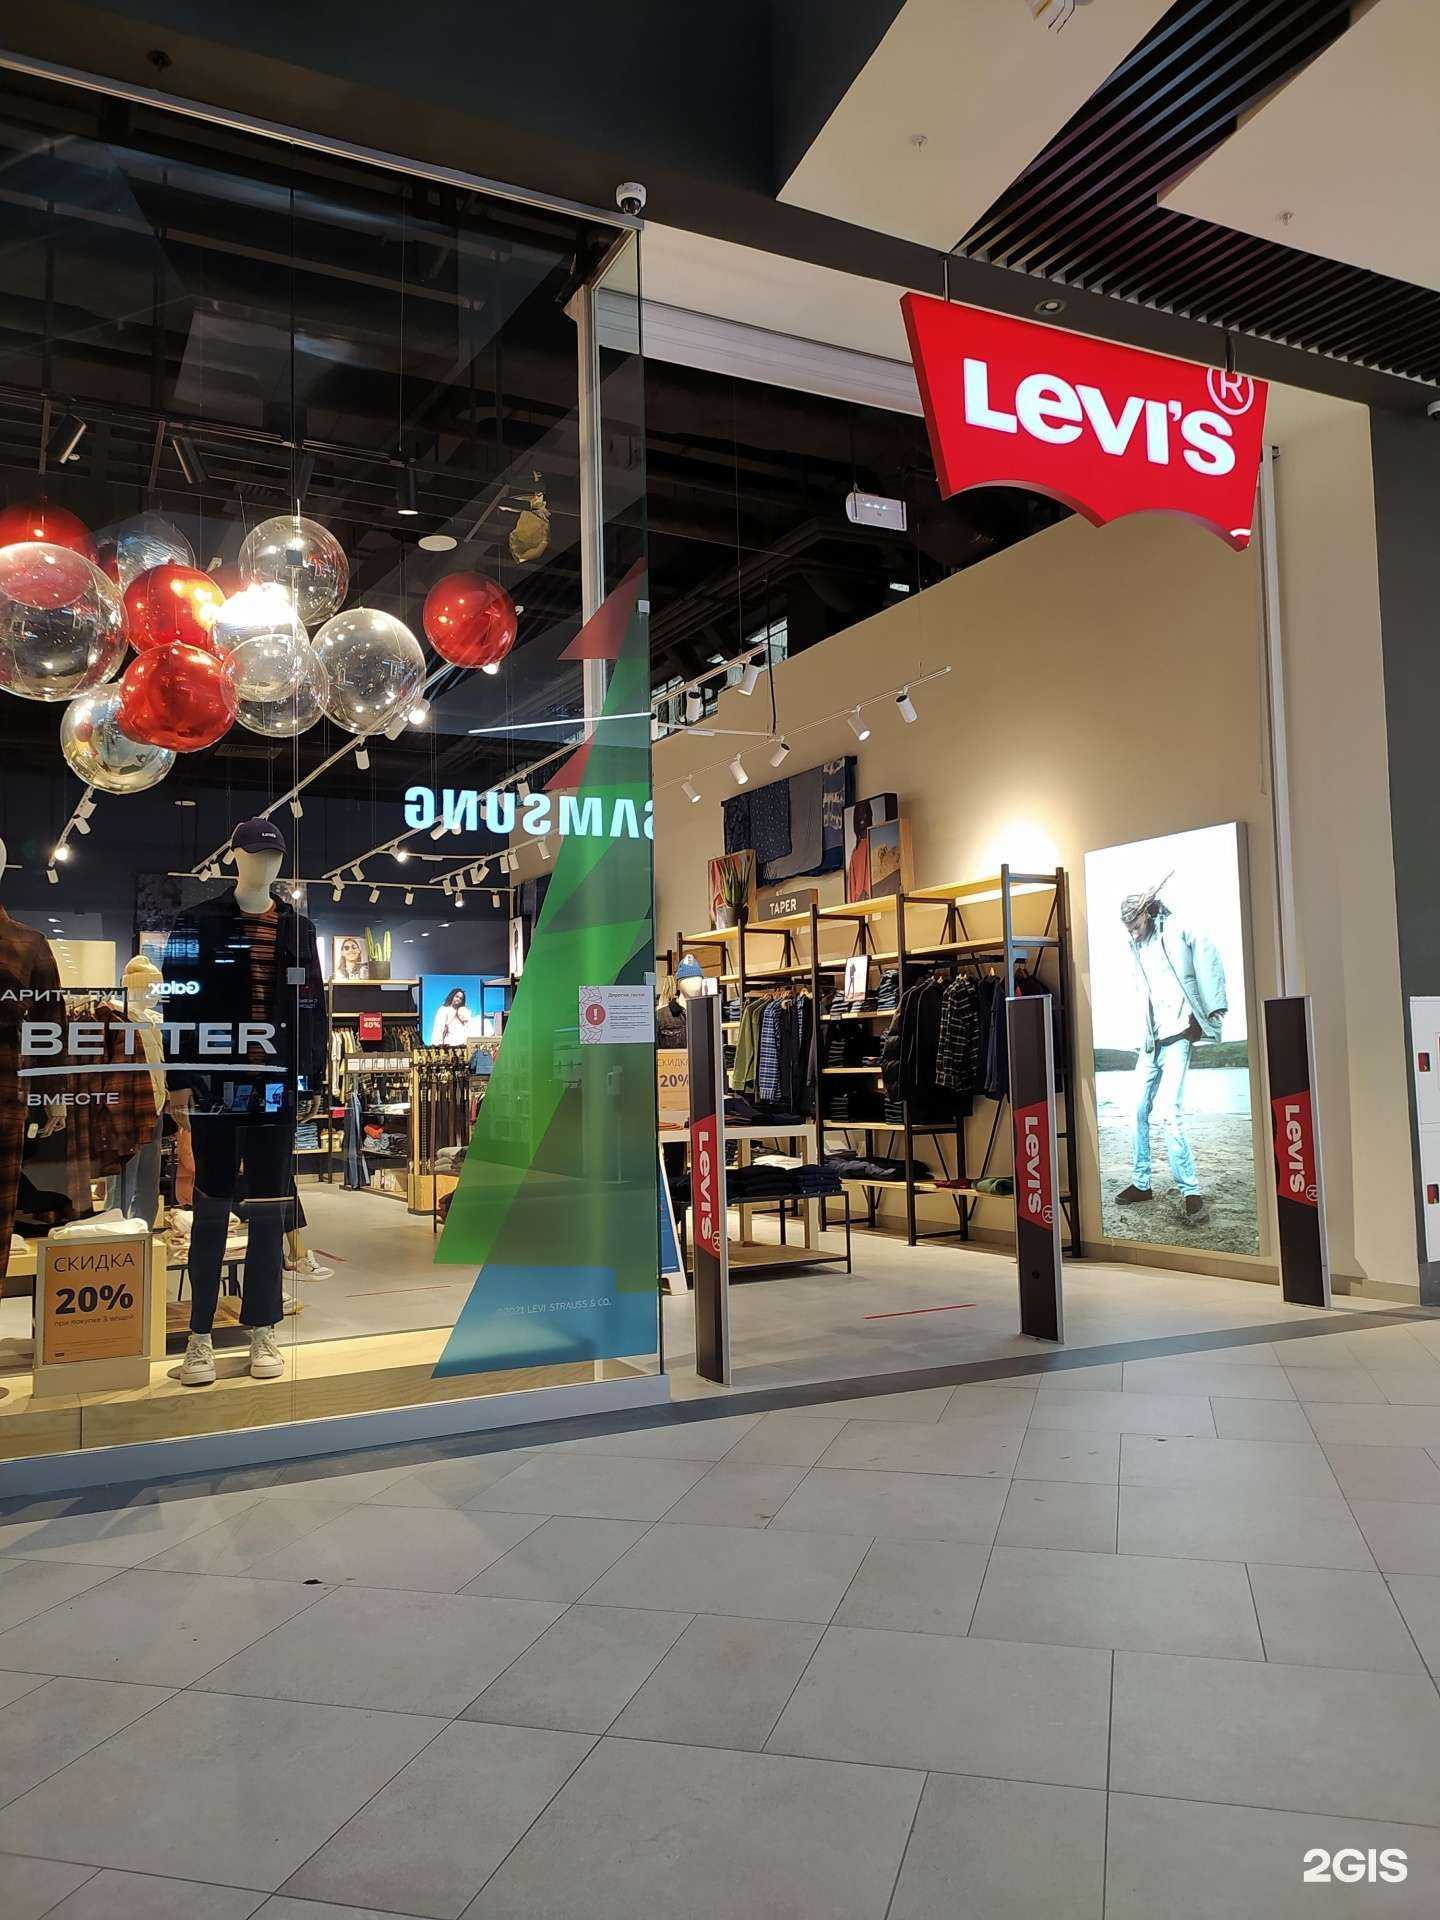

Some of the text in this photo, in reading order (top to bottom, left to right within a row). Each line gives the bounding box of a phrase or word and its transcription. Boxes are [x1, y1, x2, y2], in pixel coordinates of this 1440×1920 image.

[963, 357, 1237, 477] Levi's
[769, 898, 797, 916] TAPER
[21, 1022, 277, 1056] BETTER
[27, 1092, 120, 1106] ВМЕСТЕ
[1024, 1116, 1042, 1214] Levi's
[1285, 1104, 1306, 1193] Levi's
[699, 1131, 712, 1240] Levi's
[54, 1253, 135, 1273] СКИДКА
[55, 1283, 134, 1315] 20%
[550, 1299, 587, 1312] STRAUSS
